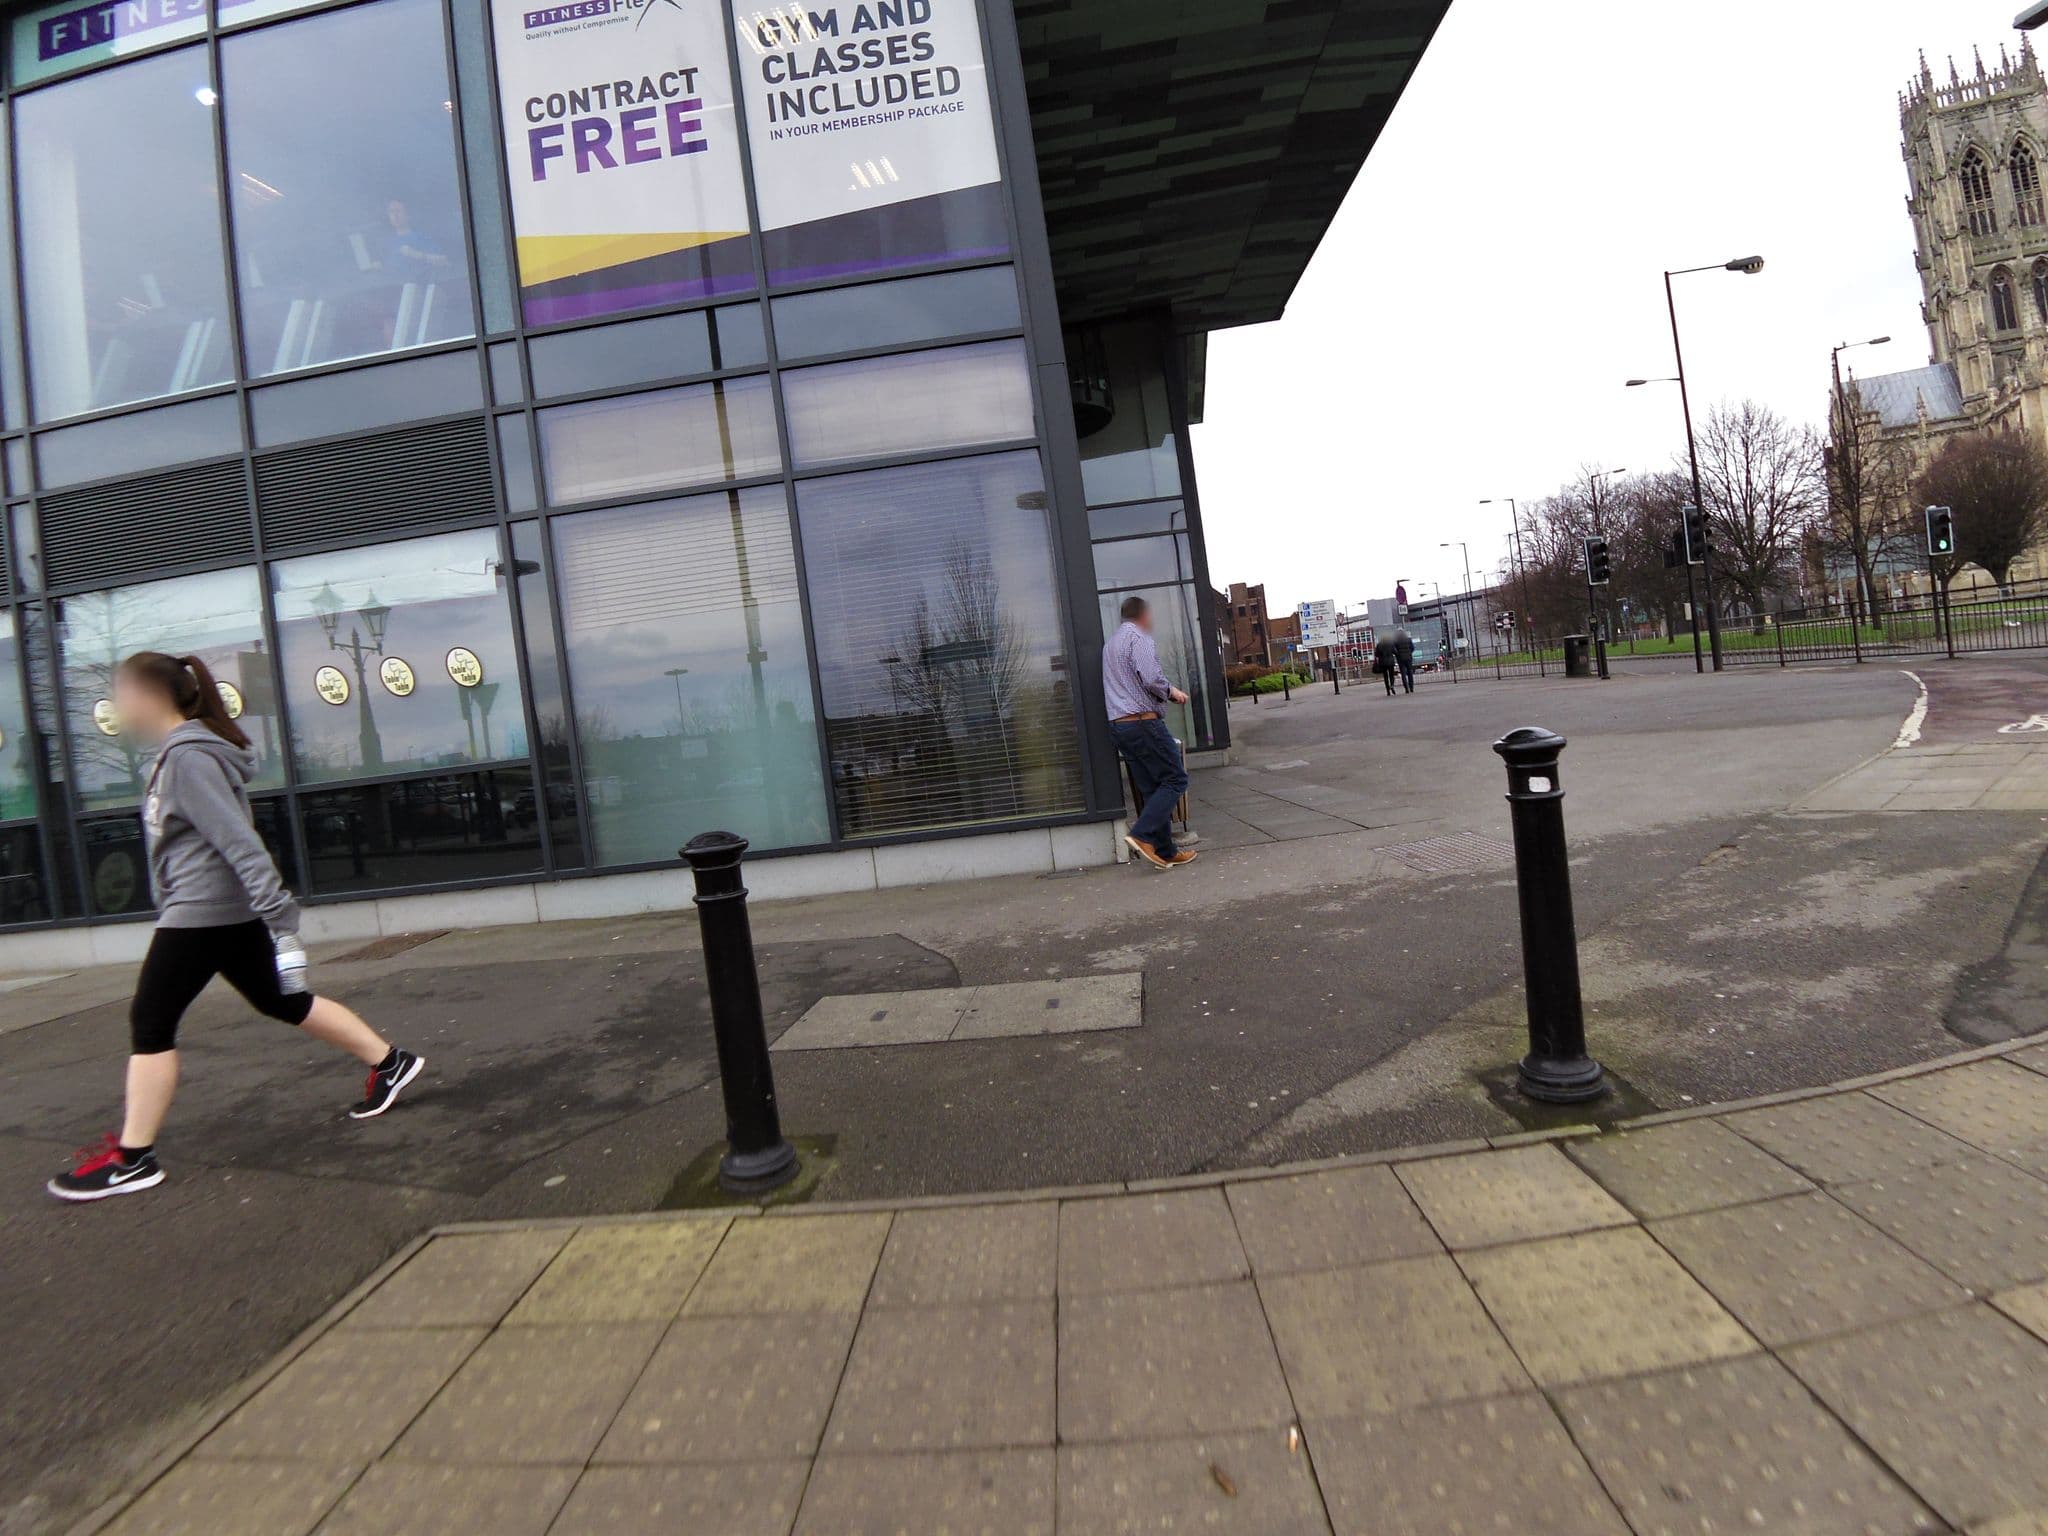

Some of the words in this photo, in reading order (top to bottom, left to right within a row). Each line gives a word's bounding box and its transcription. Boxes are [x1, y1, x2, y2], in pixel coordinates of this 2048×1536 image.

[525, 29, 551, 41] Quality
[553, 24, 581, 36] without
[583, 15, 630, 30] Compromise
[529, 2, 605, 25] FITNESS
[757, 8, 839, 47] GYM
[851, 0, 932, 34] AND
[762, 31, 935, 84] CLASSES
[525, 67, 699, 123] CONTRACT
[767, 65, 961, 123] INCLUDED
[528, 98, 708, 182] FREE
[770, 130, 783, 141] IN
[786, 122, 819, 138] YOUR
[822, 110, 905, 132] MEMBERSHIP
[908, 101, 965, 119] PACKAGE
